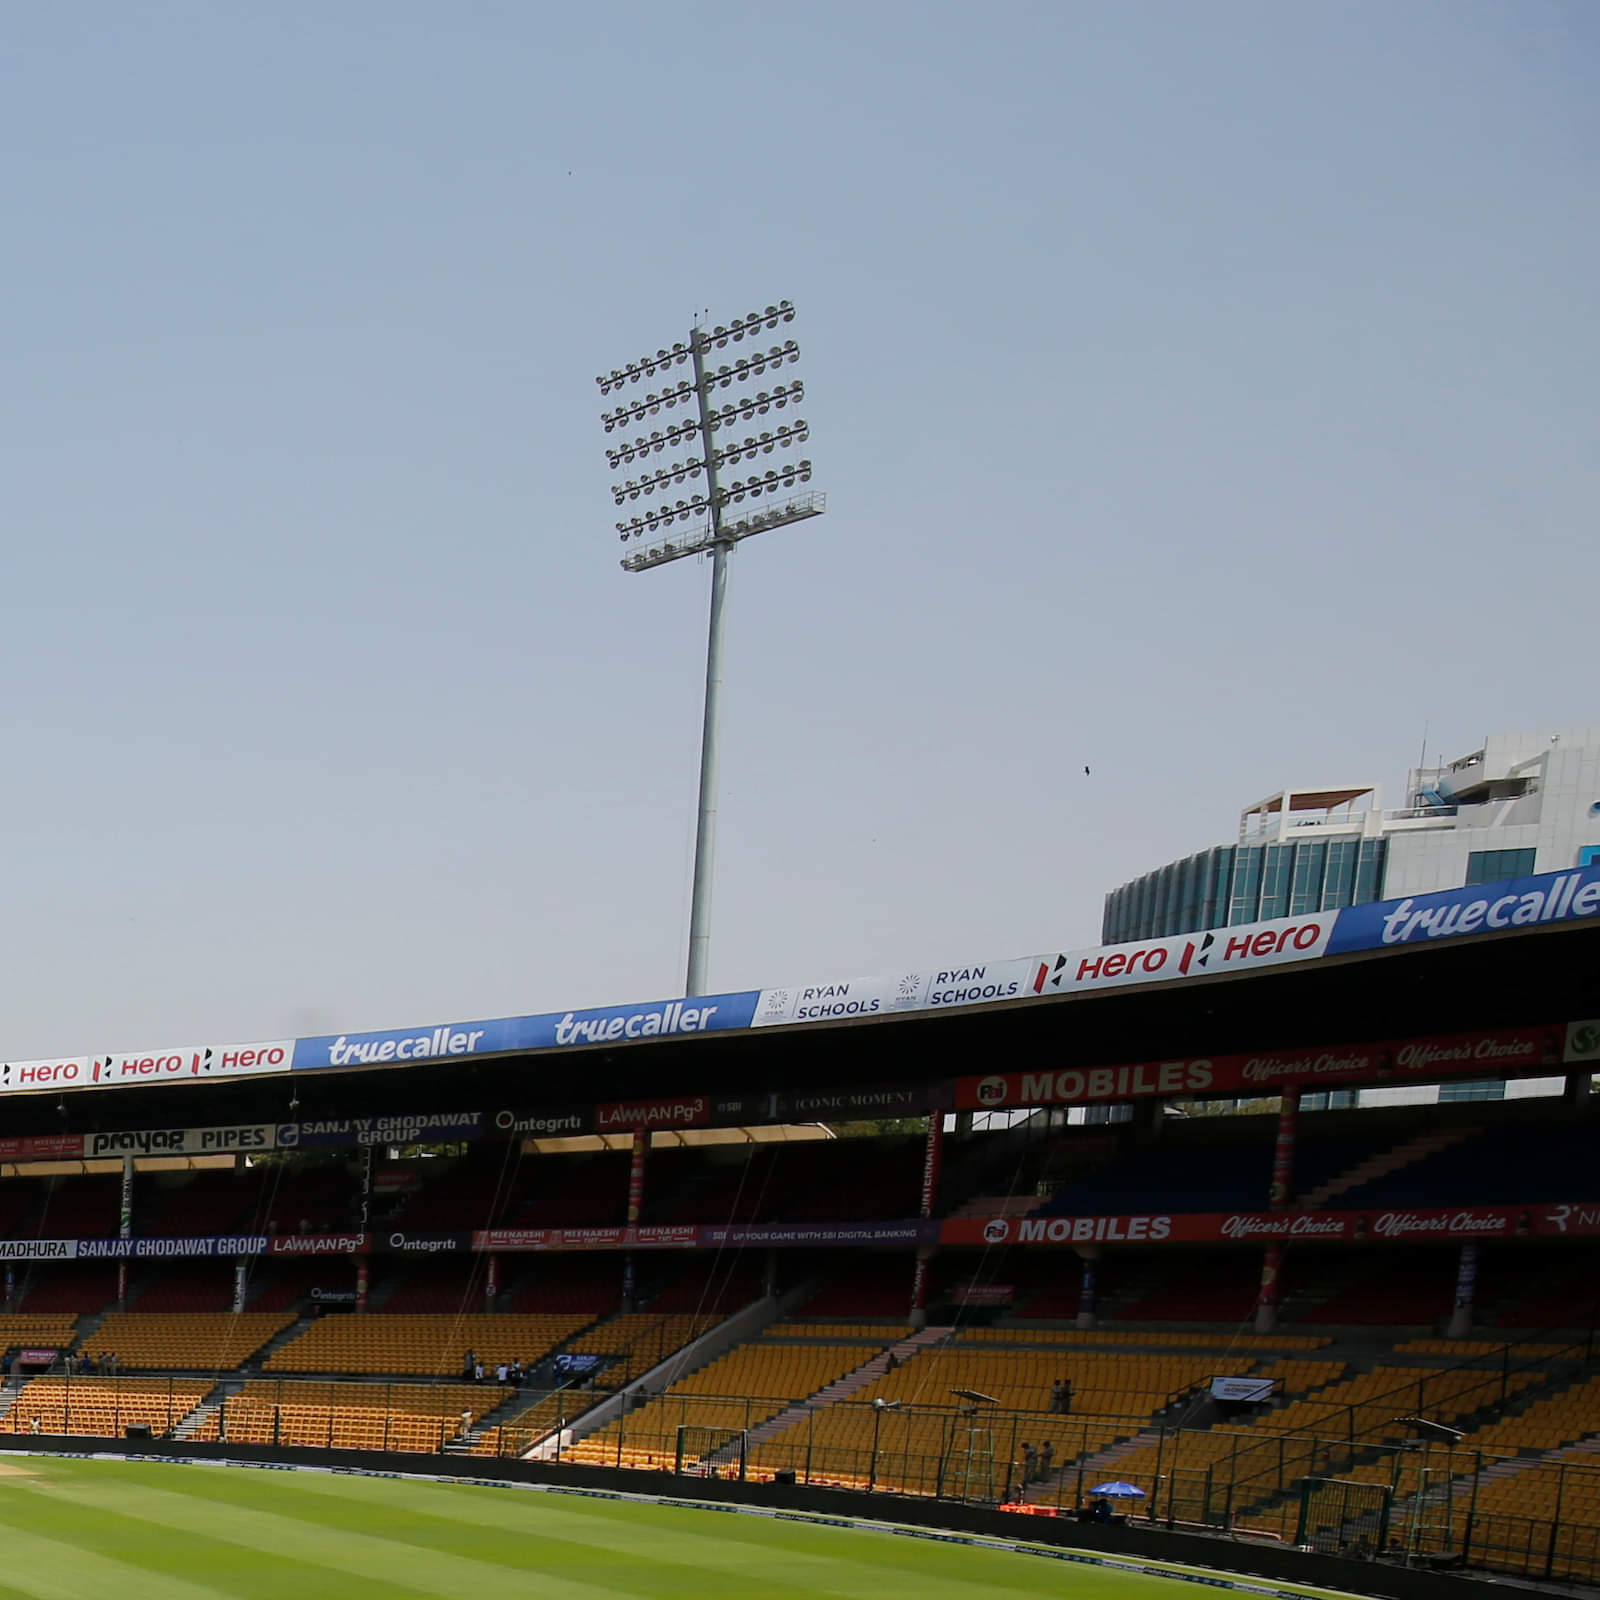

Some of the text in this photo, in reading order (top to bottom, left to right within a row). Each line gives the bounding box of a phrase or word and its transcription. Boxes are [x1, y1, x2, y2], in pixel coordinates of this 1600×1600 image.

[1223, 922, 1321, 961] Hero
[1074, 945, 1170, 982] Hero
[934, 966, 986, 986] RYAN
[802, 984, 850, 1001] RYAN
[930, 981, 1018, 1006] SCHOOLS
[796, 998, 880, 1020] SCHOOLS
[554, 1001, 720, 1046] truecaller
[221, 1047, 285, 1069] Hero
[327, 1028, 485, 1066] truecaller
[1474, 1037, 1535, 1060] Choice
[19, 1063, 80, 1083] Hero
[121, 1055, 183, 1076] Hero
[1308, 1053, 1369, 1074] Choice
[1020, 1058, 1214, 1102] MOBILES
[376, 1111, 483, 1131] GHODAWAT
[93, 1128, 266, 1155] prayag PIPES
[357, 1127, 421, 1144] GROUP
[1017, 1216, 1173, 1242] MOBILES
[1220, 1215, 1345, 1238] Officer's Choice
[1373, 1212, 1507, 1237] Officer's Choice
[77, 1236, 267, 1257] SANJAY GHODAWAT GROUP
